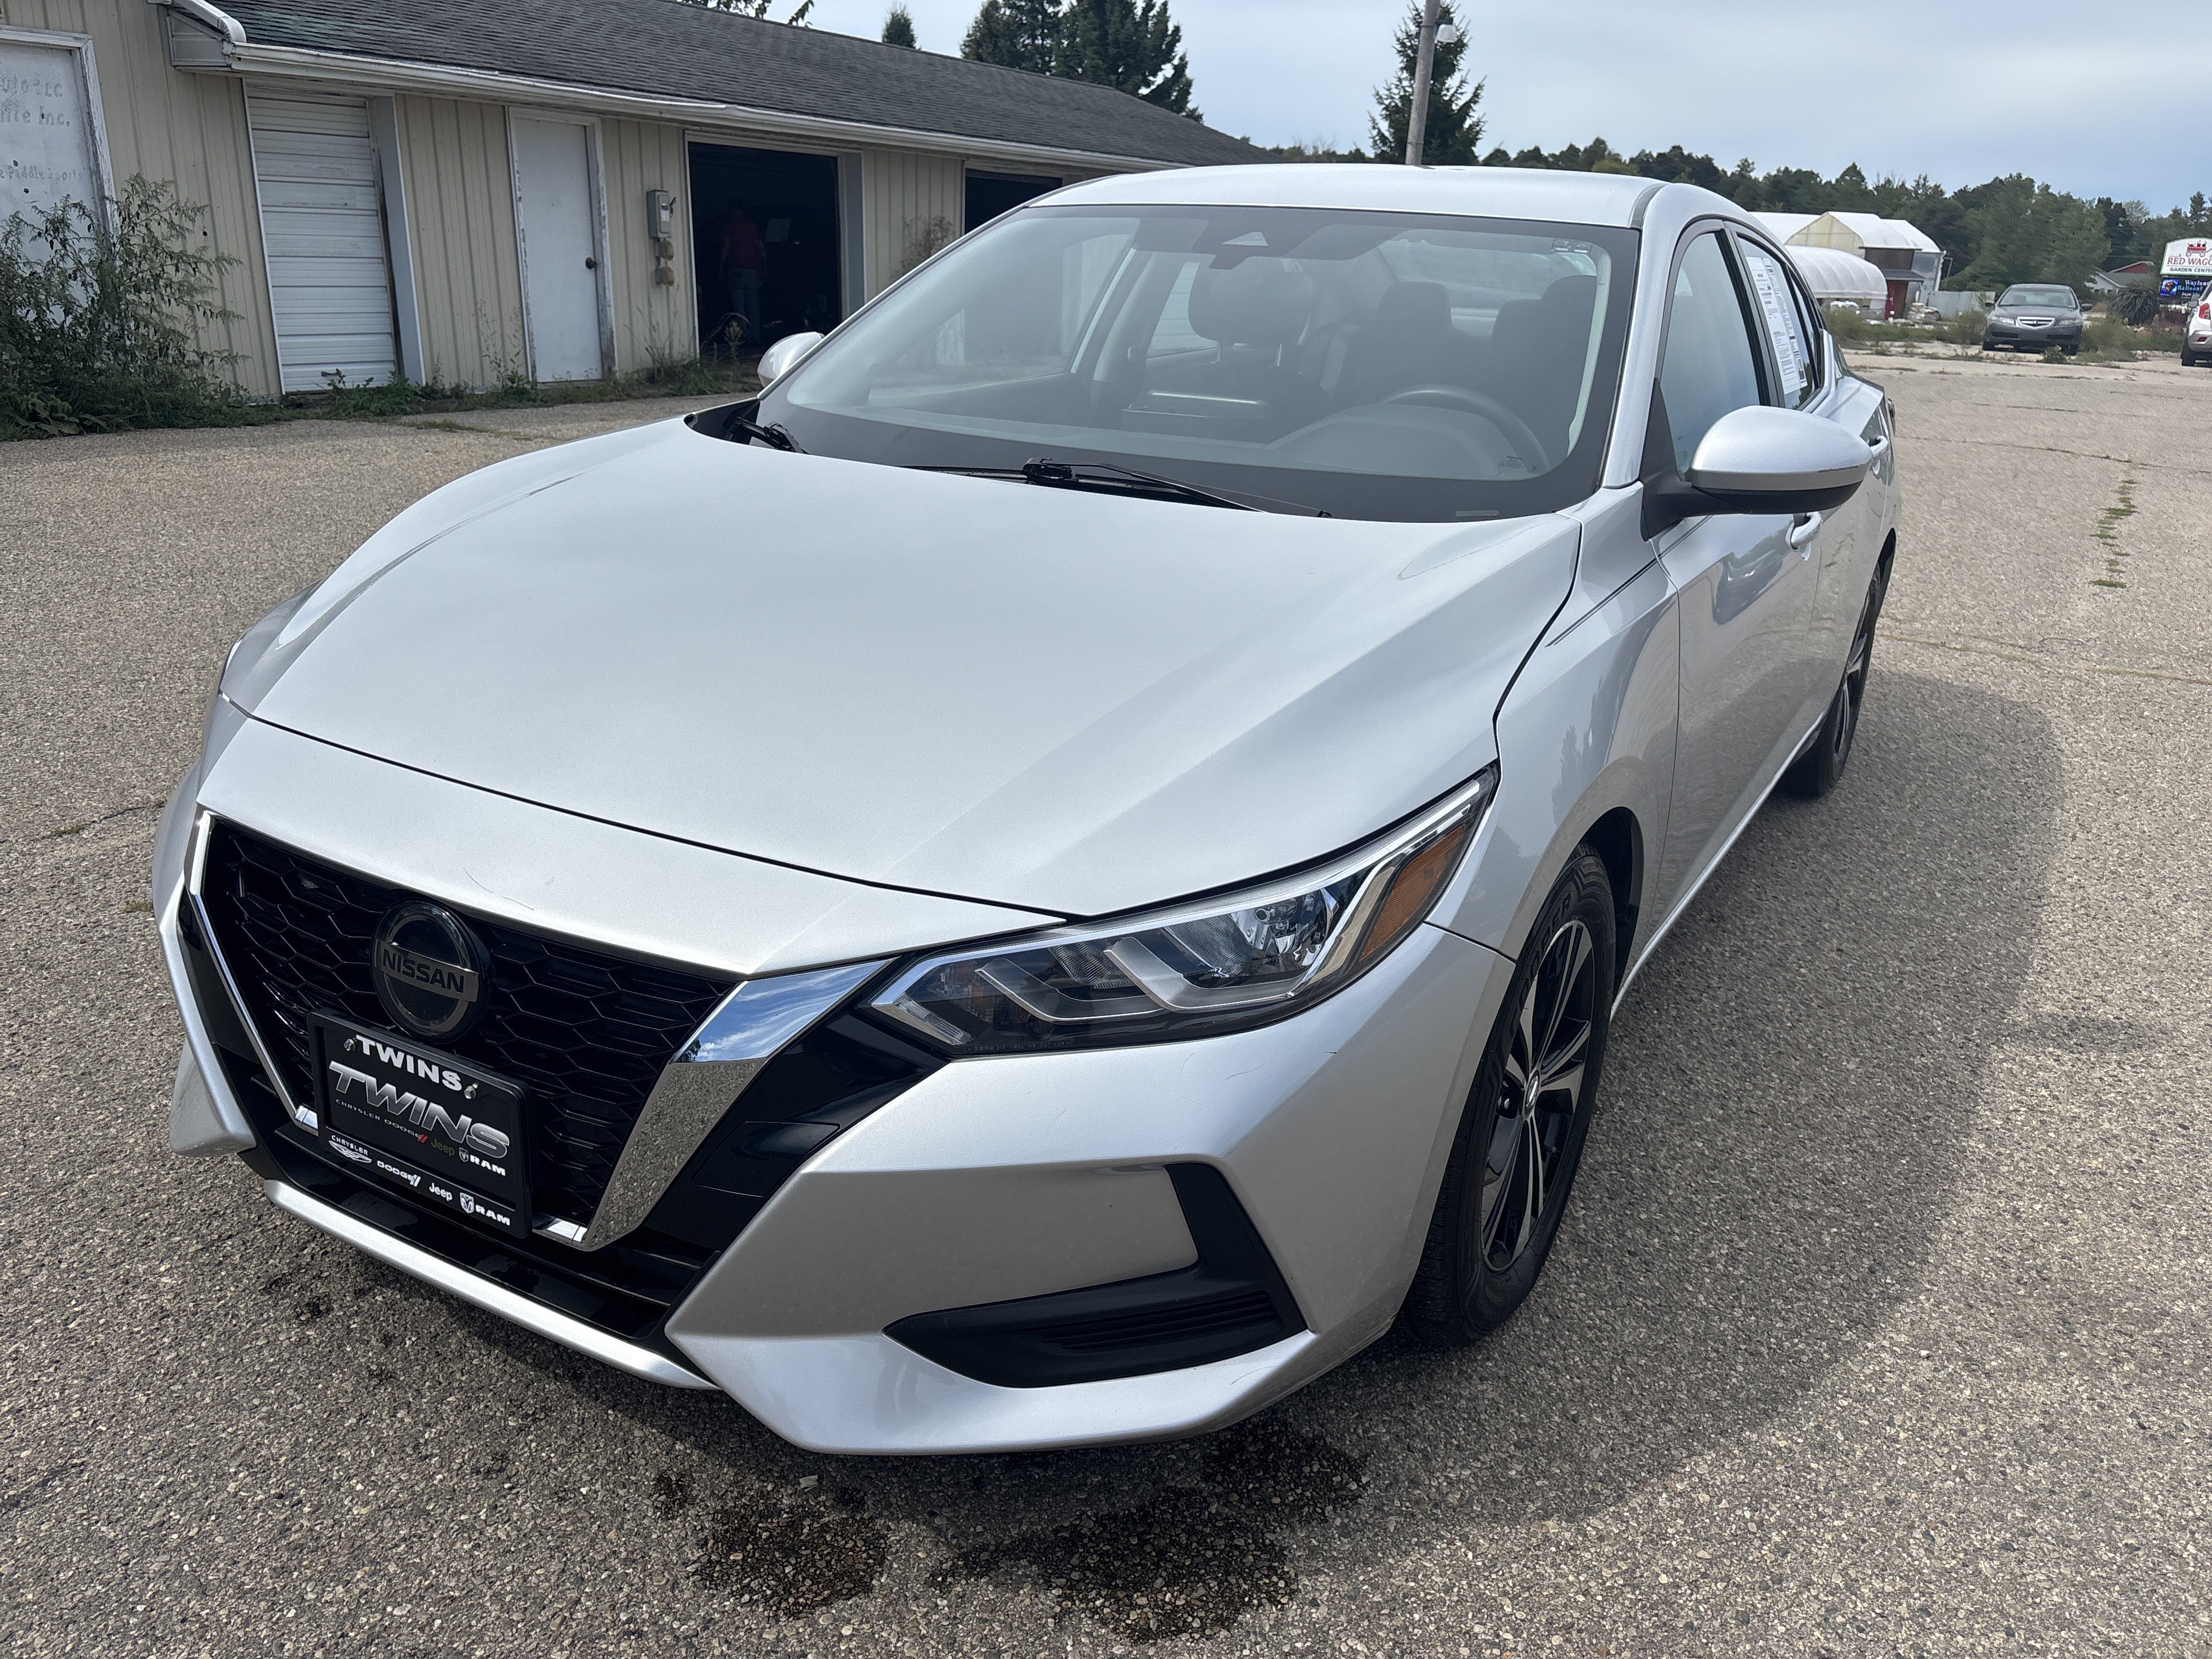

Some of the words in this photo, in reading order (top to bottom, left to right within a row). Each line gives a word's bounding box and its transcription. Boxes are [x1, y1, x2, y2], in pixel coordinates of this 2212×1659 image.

[382, 949, 465, 994] NISSAN
[356, 1034, 462, 1091] TWINS
[329, 1060, 510, 1159] TWINS
[335, 1098, 381, 1121] CHRYSLER
[384, 1119, 422, 1138] DODGE
[431, 1138, 455, 1157] Jeep
[470, 1154, 506, 1177] RAM
[331, 1135, 369, 1156] CHRYSLER
[377, 1160, 416, 1182] DODGE
[429, 1182, 453, 1202] Jeep
[475, 1204, 511, 1227] RAM
